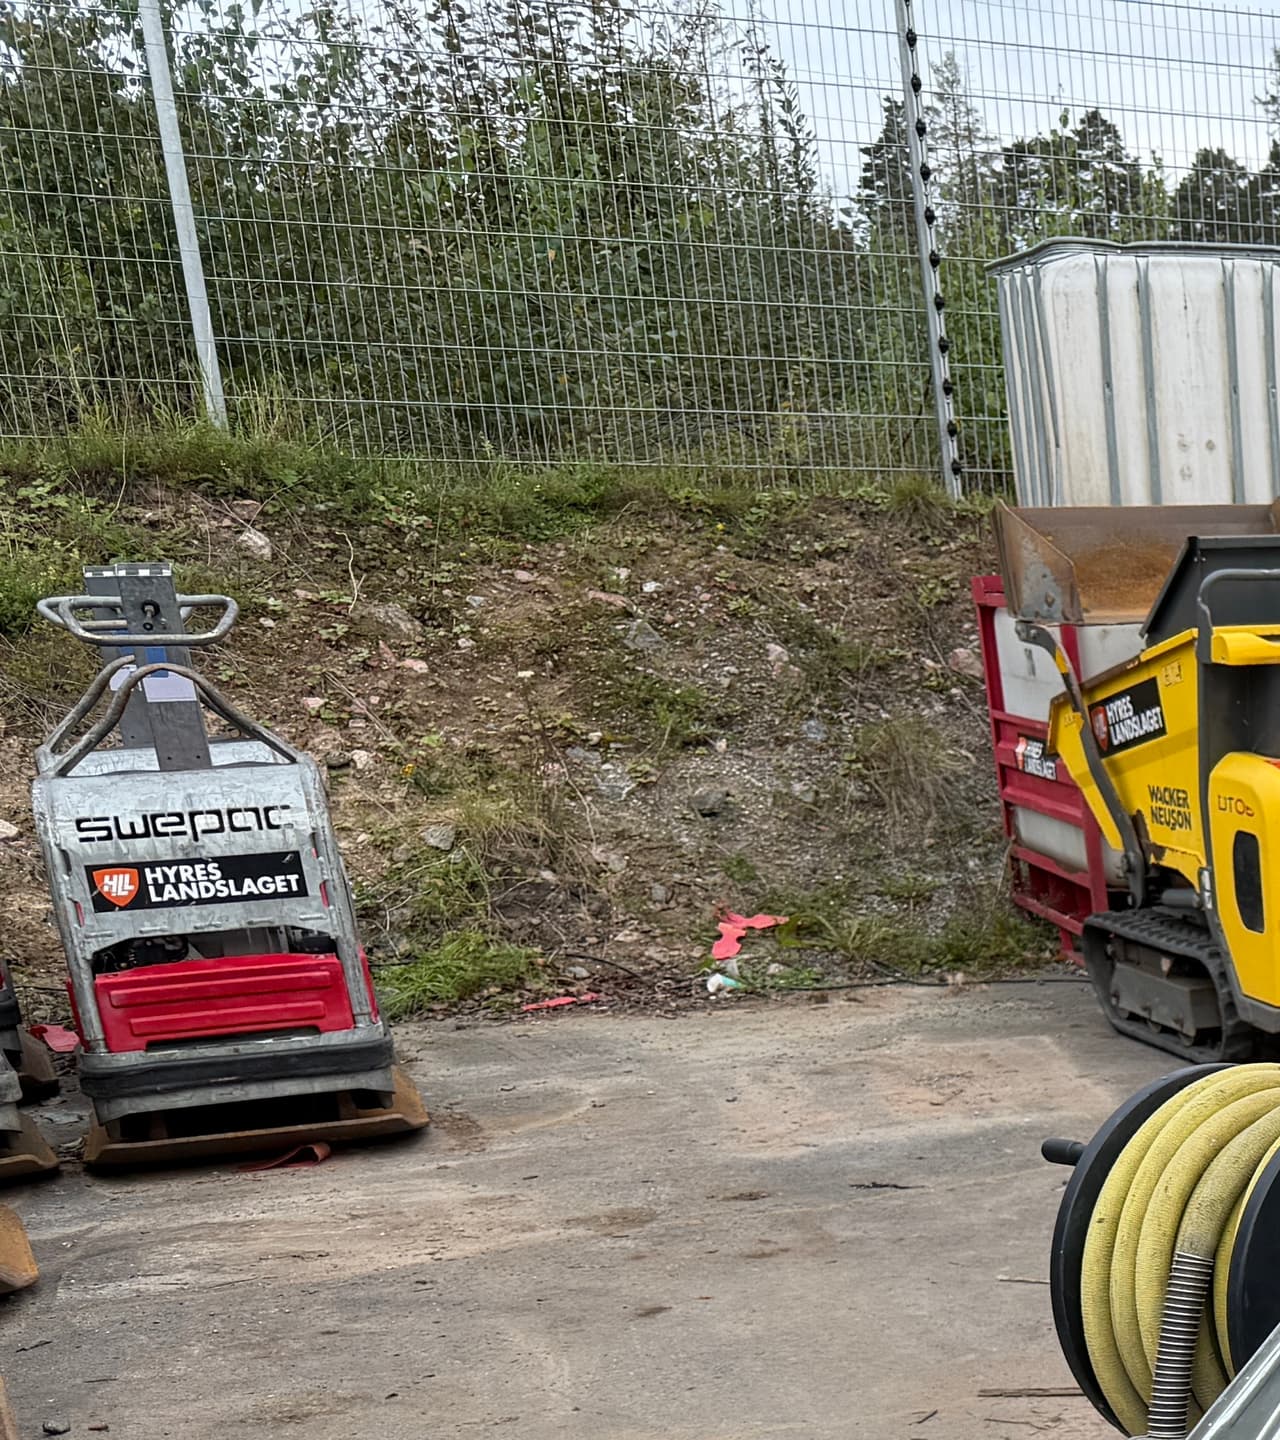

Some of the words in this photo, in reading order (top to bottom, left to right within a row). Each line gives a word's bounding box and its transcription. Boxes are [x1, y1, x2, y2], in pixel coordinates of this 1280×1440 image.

[1105, 695, 1134, 725] HYRES
[1110, 706, 1163, 746] LANDSLAGET
[1147, 784, 1190, 809] WACKER
[1150, 805, 1192, 831] NEUSON
[144, 862, 222, 885] HYRES
[147, 874, 300, 903] LANDSLAGET
